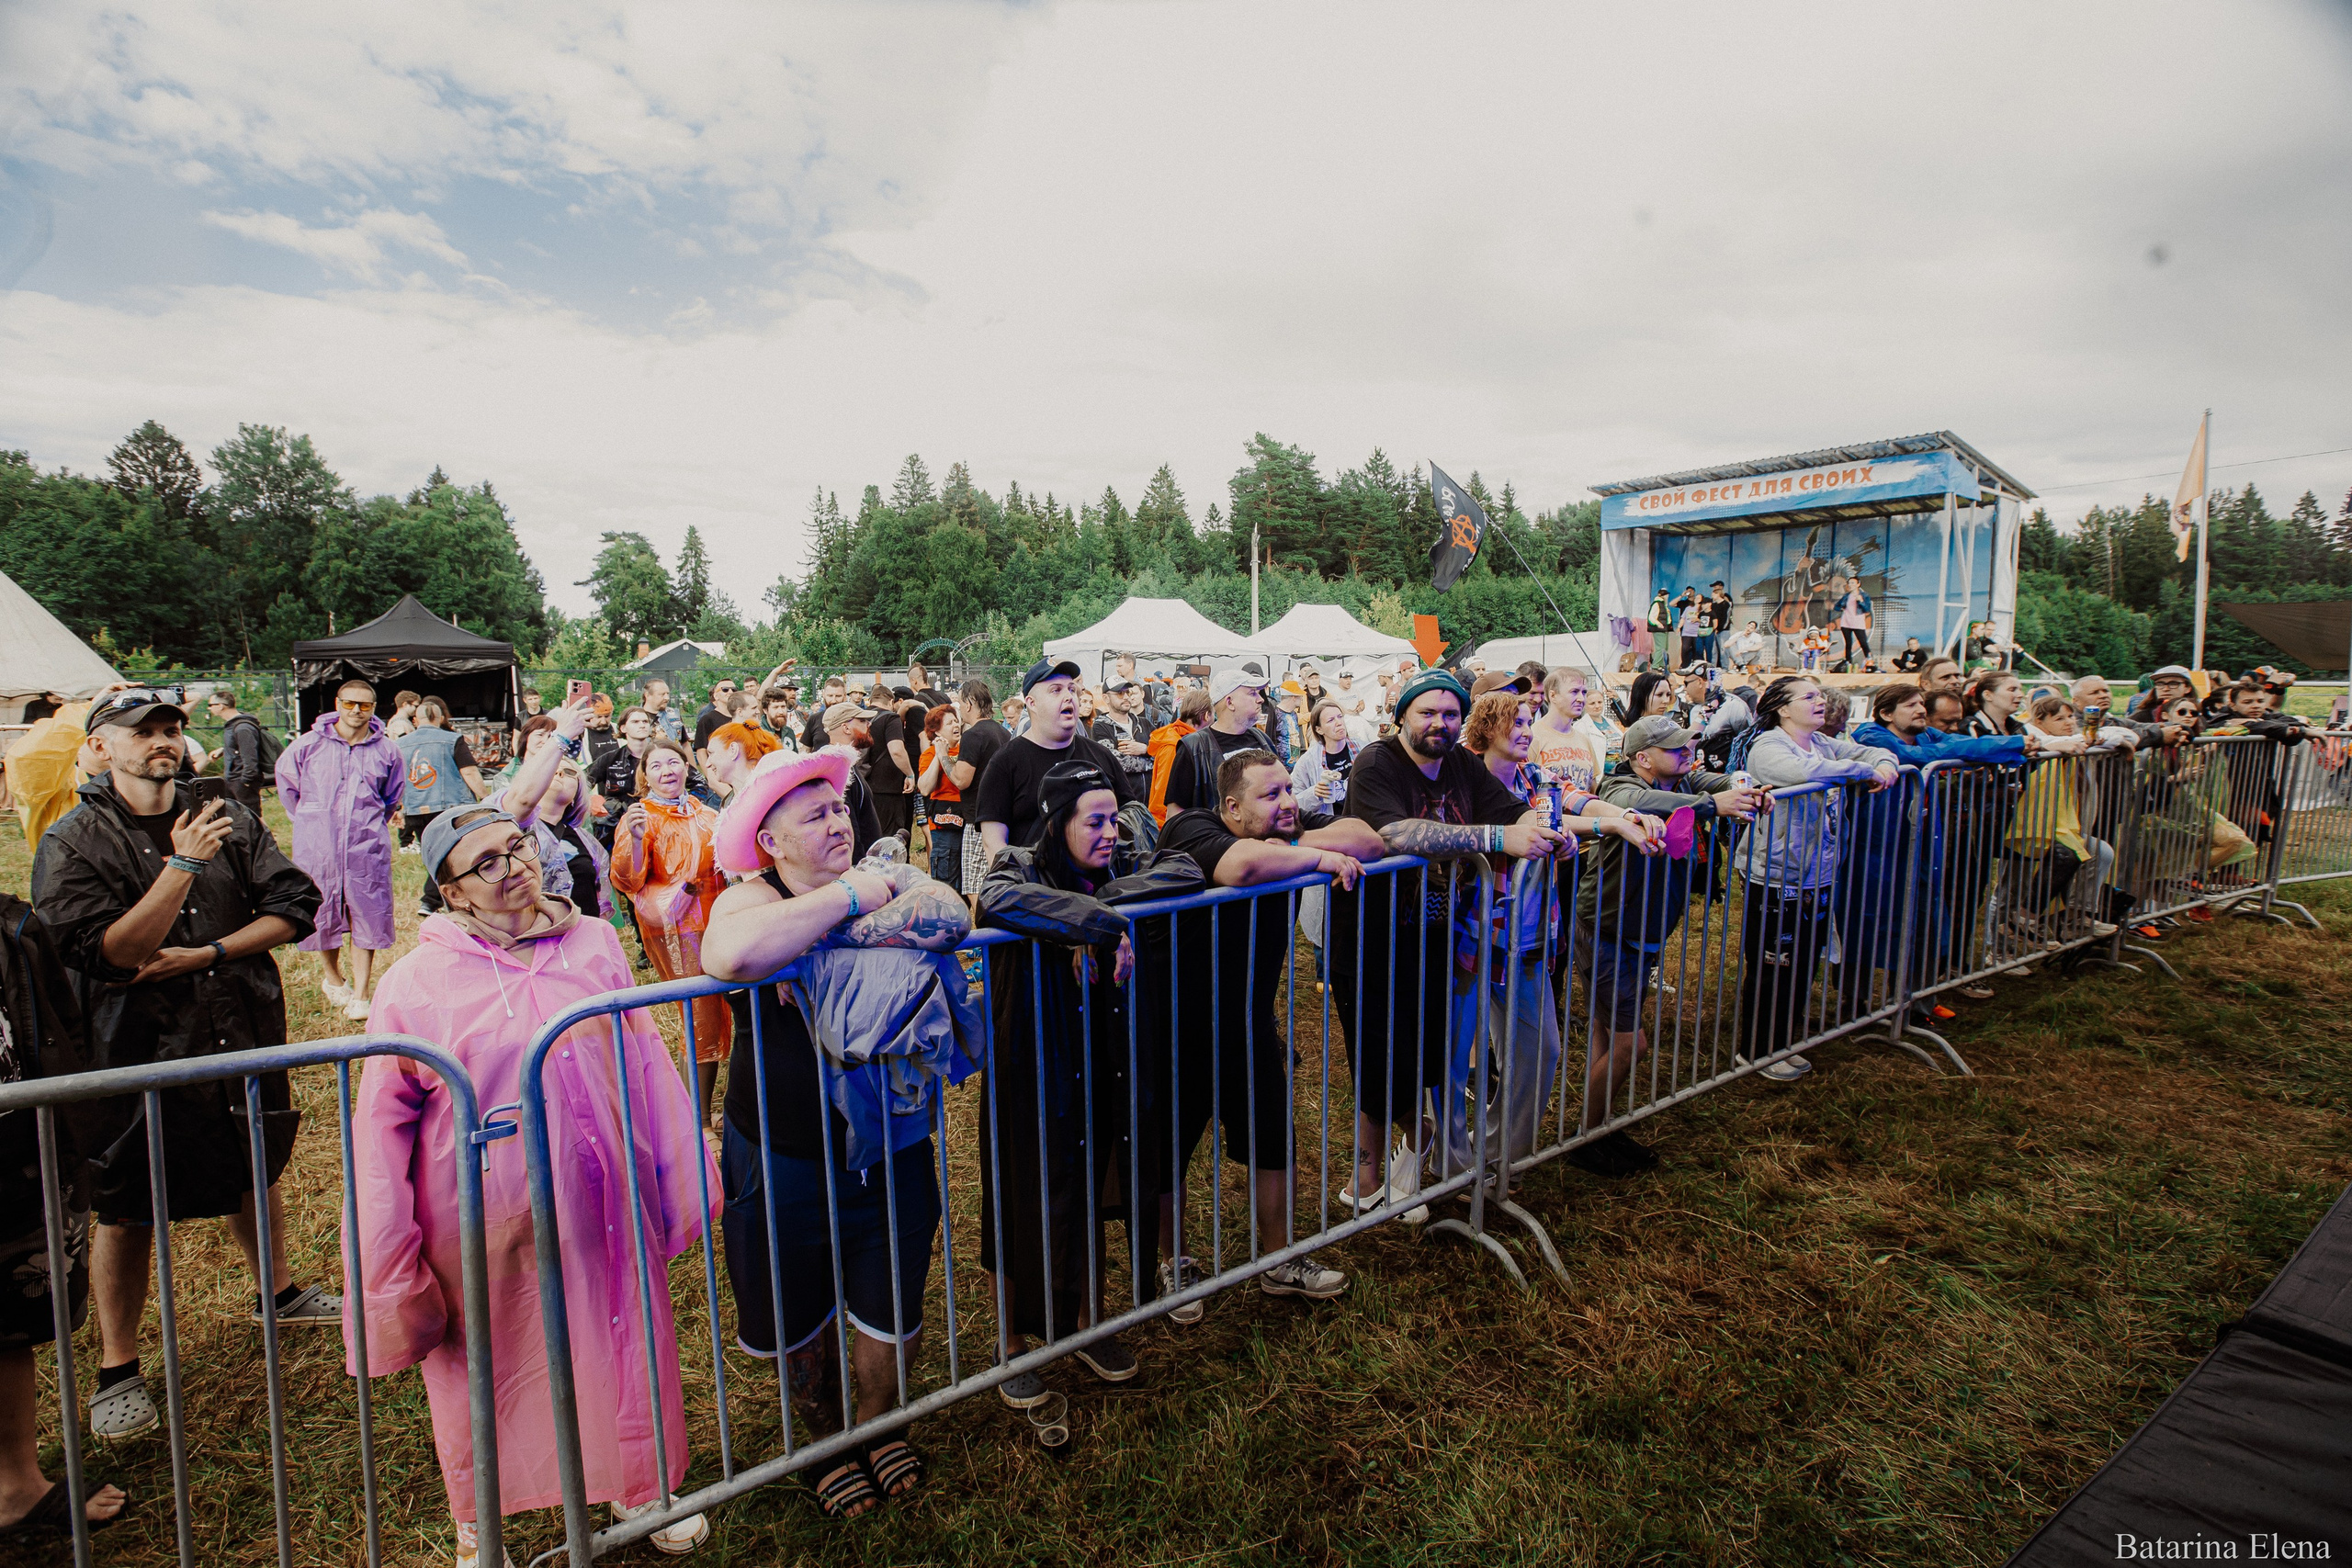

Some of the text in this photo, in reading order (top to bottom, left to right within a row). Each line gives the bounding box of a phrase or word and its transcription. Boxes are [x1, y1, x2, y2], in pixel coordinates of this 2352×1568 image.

[1640, 467, 1873, 510] СВОЙ ФЕСТ ДЛЯ СВОИХ
